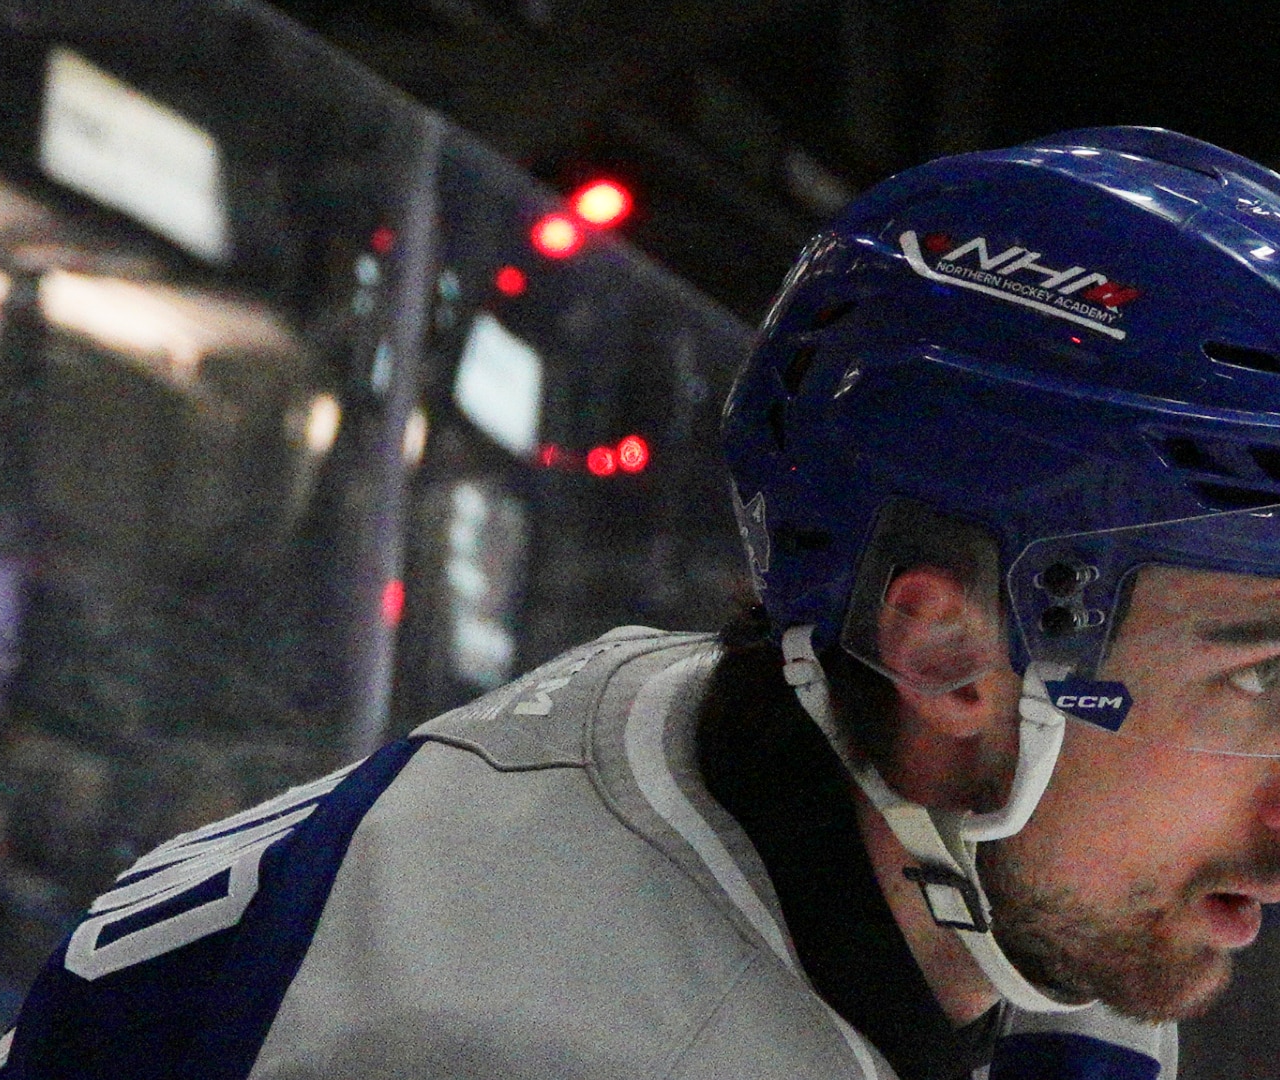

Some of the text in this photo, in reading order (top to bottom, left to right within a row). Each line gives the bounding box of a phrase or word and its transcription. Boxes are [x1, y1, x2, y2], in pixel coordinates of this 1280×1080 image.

[935, 261, 1118, 324] NORTHERN HOCKEY ACADEMY
[1055, 695, 1124, 709] CCM
